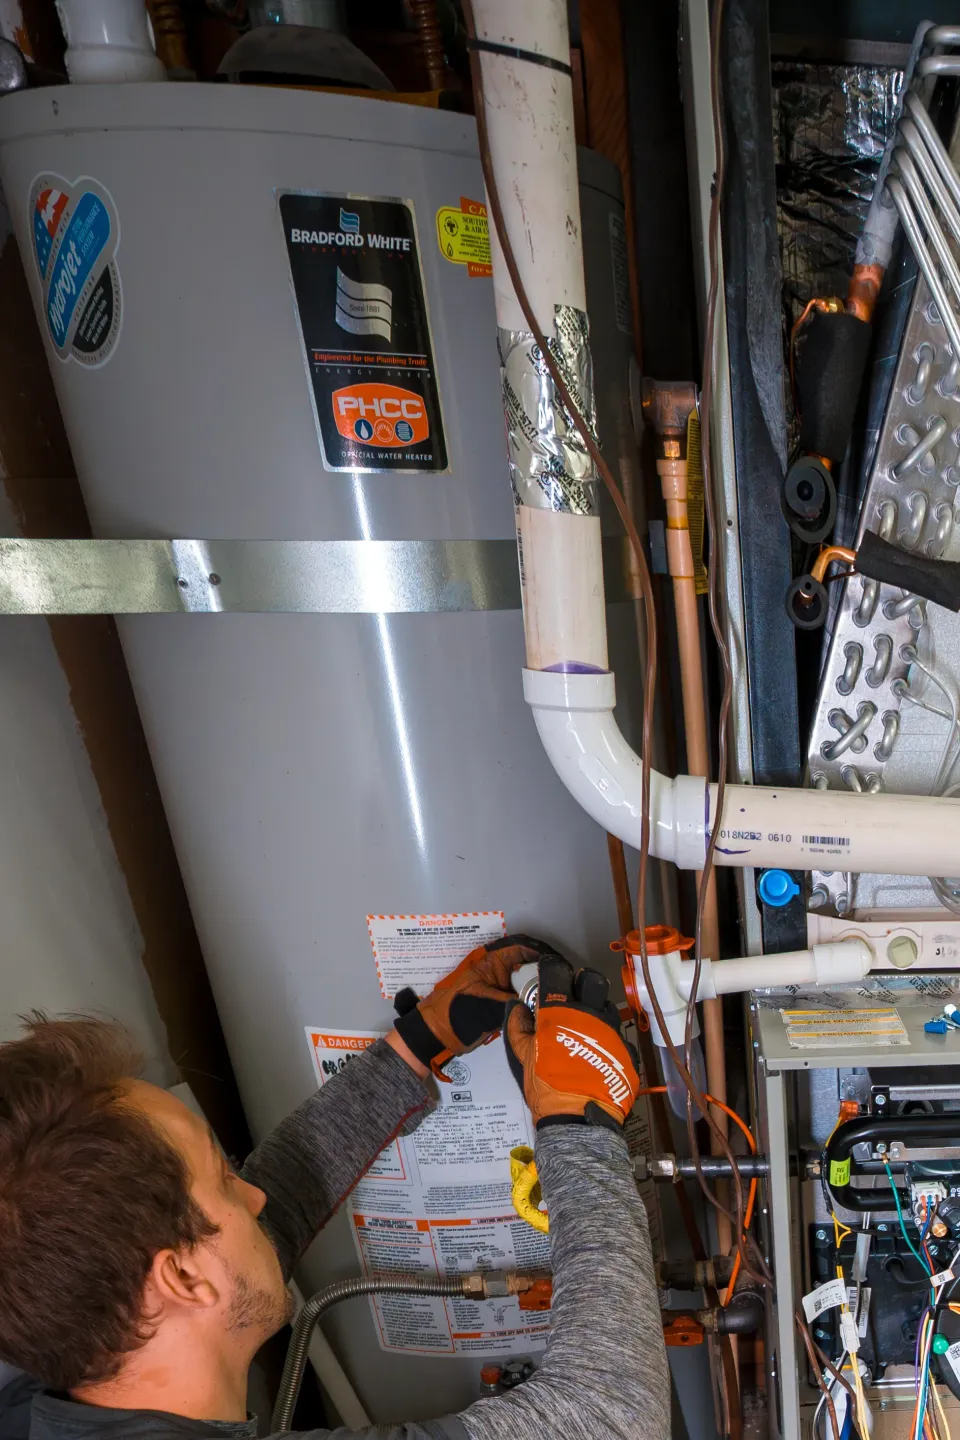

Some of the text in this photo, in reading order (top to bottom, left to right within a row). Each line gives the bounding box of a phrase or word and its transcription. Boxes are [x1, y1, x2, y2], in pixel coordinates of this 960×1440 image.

[291, 228, 410, 251] BRADFORD WHITE
[49, 239, 82, 338] Hydrojet
[366, 305, 380, 313] 1881
[314, 352, 351, 362] Engineered
[364, 355, 375, 363] the
[376, 355, 407, 365] Plumbing
[408, 357, 427, 366] Trade
[337, 396, 423, 419] PHCC
[519, 409, 539, 439] 367-17
[377, 452, 402, 460] WATER
[405, 453, 433, 461] HEATER
[768, 833, 792, 842] 0610
[556, 1031, 630, 1108] Milwaukee
